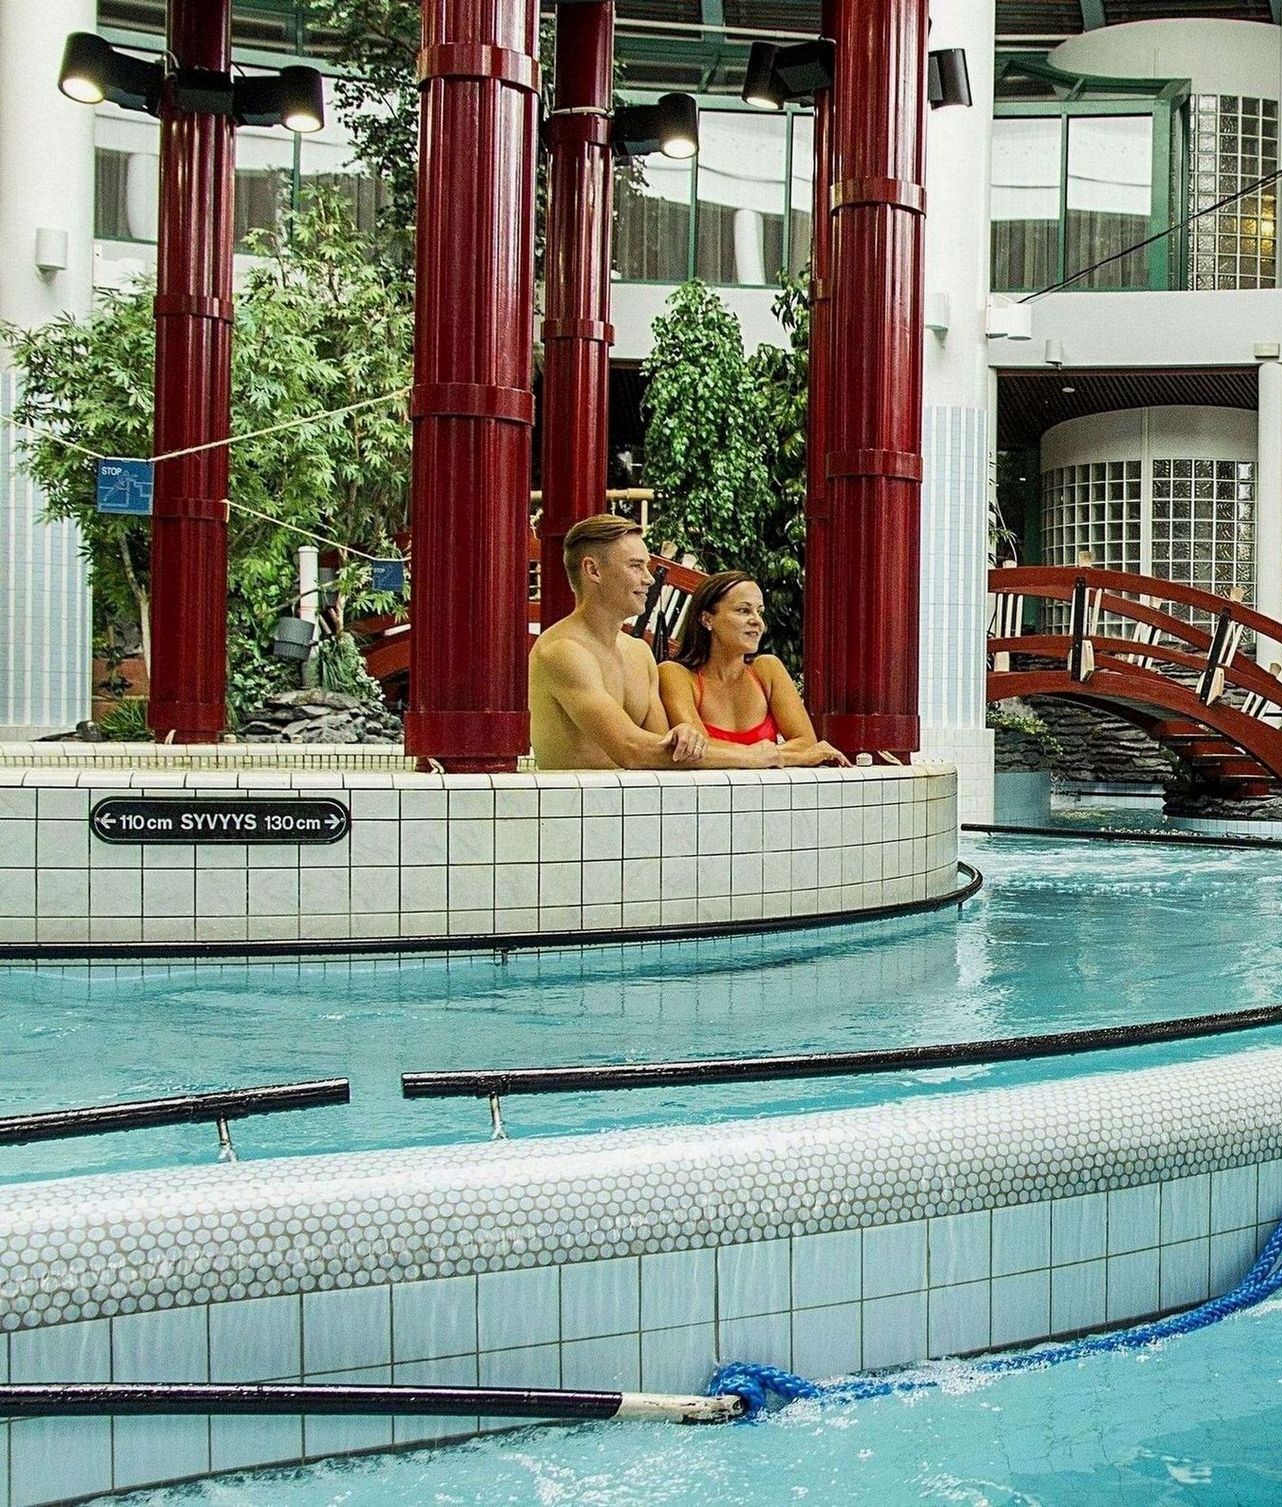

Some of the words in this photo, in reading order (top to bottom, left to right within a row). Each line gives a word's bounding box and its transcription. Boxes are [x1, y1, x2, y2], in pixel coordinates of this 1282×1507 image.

[101, 466, 122, 476] STOP
[120, 814, 145, 830] 110
[146, 818, 173, 830] cm
[180, 813, 257, 830] SYVYYS
[264, 815, 294, 830] 130
[296, 818, 321, 830] cm
